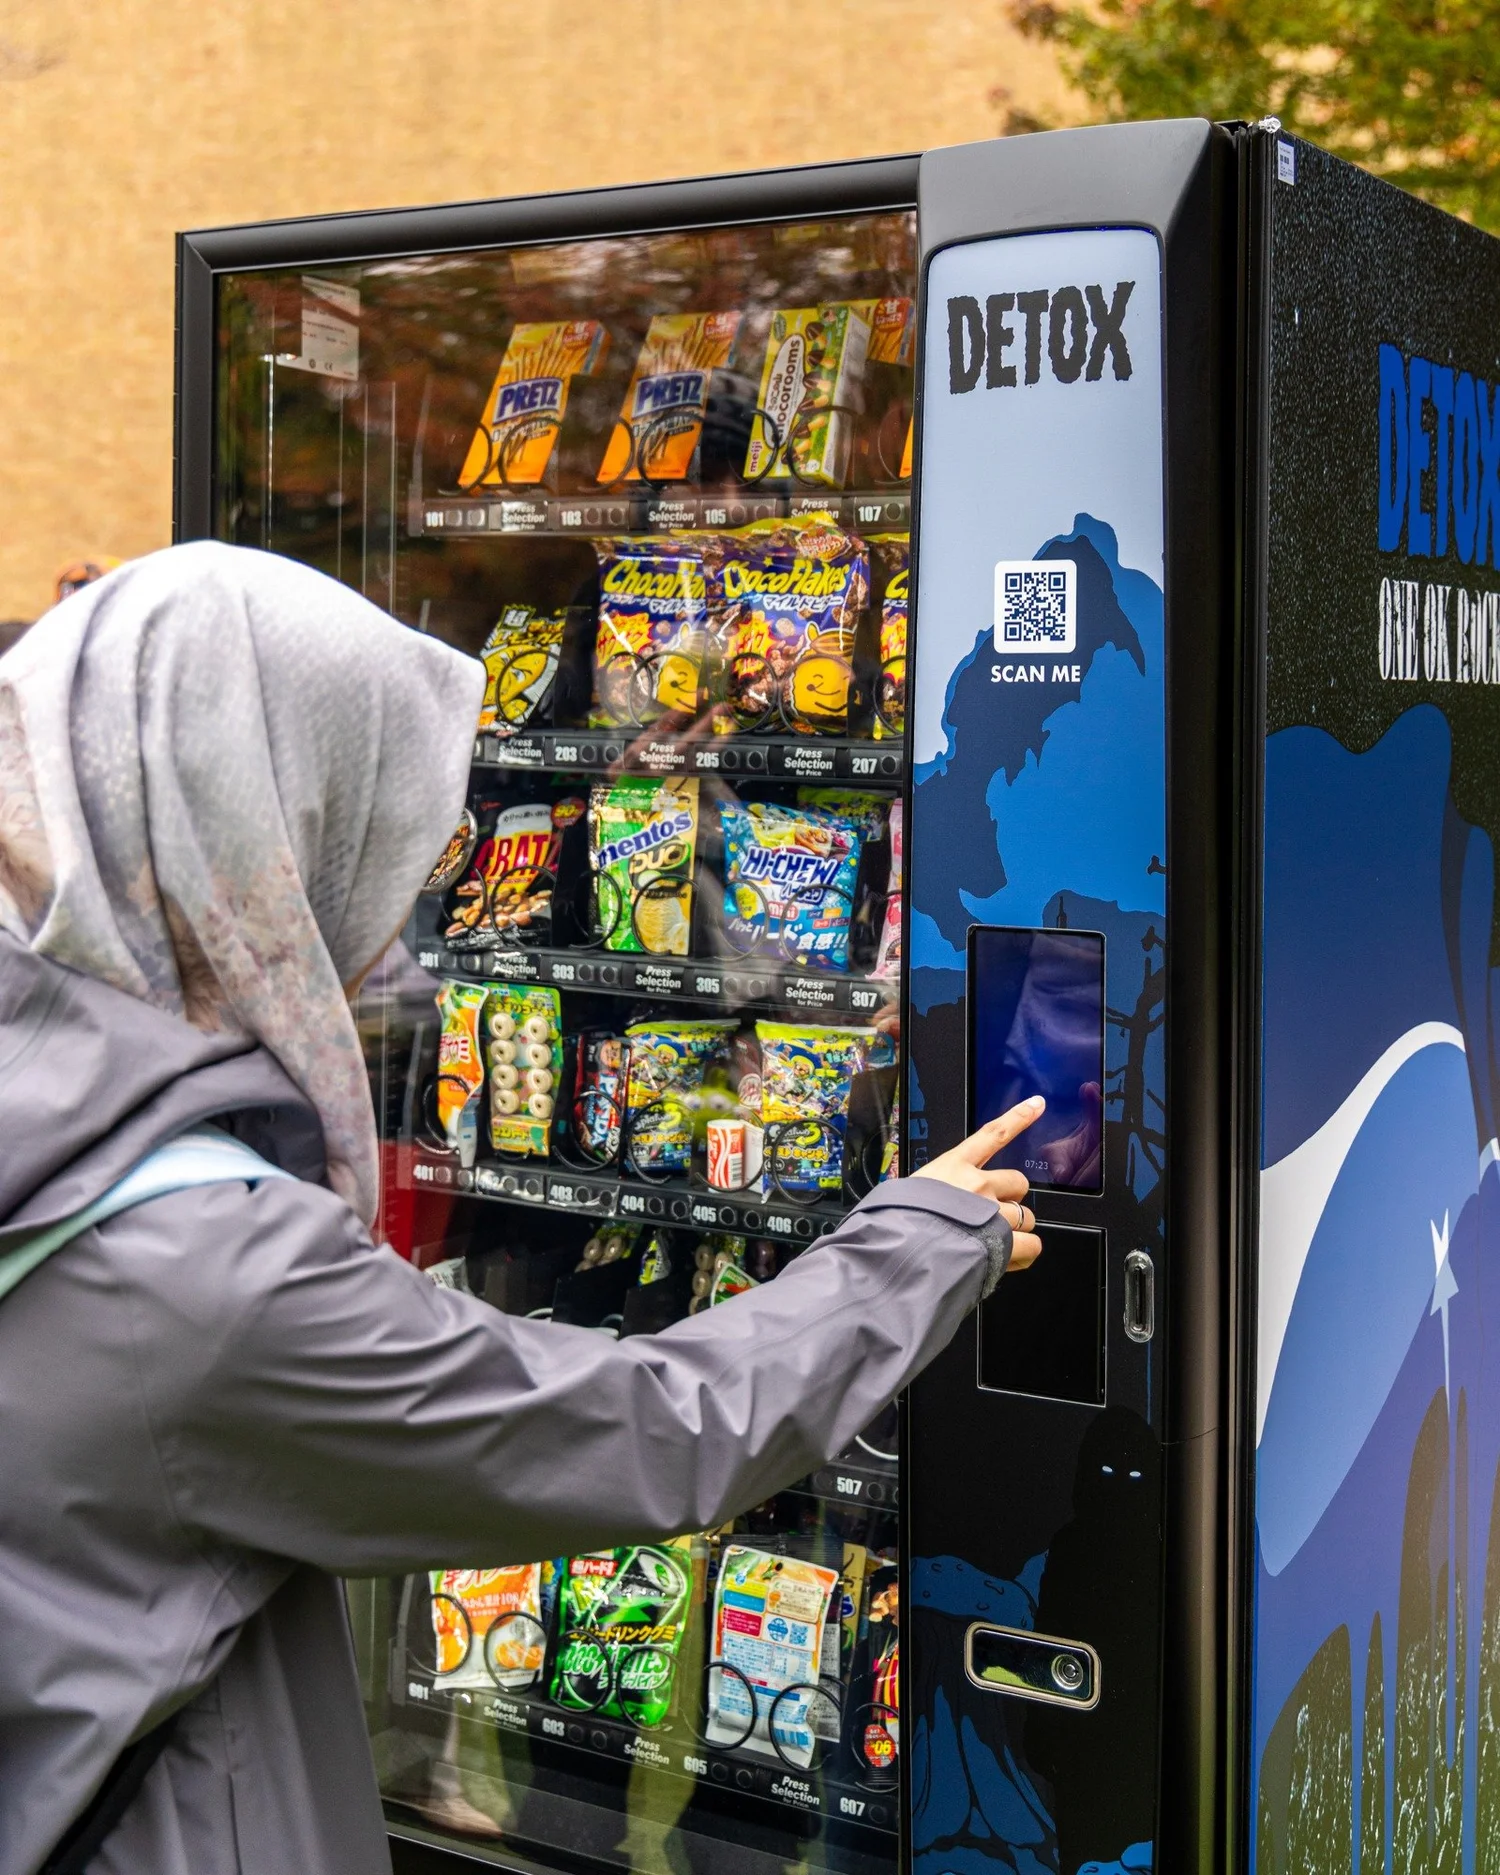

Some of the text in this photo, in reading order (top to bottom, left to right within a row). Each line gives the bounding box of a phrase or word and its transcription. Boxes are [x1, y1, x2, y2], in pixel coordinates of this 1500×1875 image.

[946, 280, 1136, 395] DETOX
[498, 381, 561, 419] PRETZ
[636, 376, 703, 413] PRETZ
[750, 441, 763, 473] meiji
[1378, 341, 1500, 572] DETOX
[659, 501, 684, 512] Press
[802, 498, 829, 510] Press
[426, 511, 444, 528] 101
[502, 512, 545, 524] Selection
[560, 510, 582, 526] 103
[648, 511, 694, 523] Selection
[705, 510, 726, 525] 105
[858, 506, 882, 522] 107
[1379, 577, 1419, 680] ONE
[1424, 583, 1451, 682] OK
[990, 665, 1081, 683] SCAN ME
[555, 746, 577, 762] 203
[649, 742, 675, 753] Press
[795, 748, 822, 758] Press
[639, 751, 685, 763] Selection
[696, 752, 719, 768] 205
[784, 758, 832, 770] Selection
[852, 758, 878, 774] 207
[597, 812, 693, 869] mentos
[471, 833, 560, 879] CRATZ
[629, 844, 685, 874] DUO
[741, 846, 841, 888] HI-CHEW
[419, 952, 439, 968] 301
[552, 964, 574, 980] 303
[645, 965, 672, 977] Press
[636, 974, 681, 988] Selection
[696, 977, 720, 994] 305
[796, 978, 824, 989] Press
[786, 987, 834, 1001] Selection
[852, 991, 877, 1007] 307
[413, 1164, 434, 1181] 401
[1025, 1159, 1049, 1170] 07:23
[551, 1184, 573, 1201] 403
[621, 1194, 645, 1212] 404
[693, 1205, 717, 1223] 405
[767, 1216, 792, 1234] 406
[837, 1476, 862, 1496] 507
[408, 1682, 429, 1700] 601
[493, 1698, 518, 1714] Press
[483, 1705, 527, 1727] Selection
[542, 1717, 565, 1738] 603
[634, 1736, 660, 1752] Press
[624, 1743, 670, 1765] Selection
[683, 1755, 708, 1775] 605
[782, 1775, 810, 1792] Press
[771, 1783, 820, 1806] Selection
[840, 1797, 866, 1817] 607
